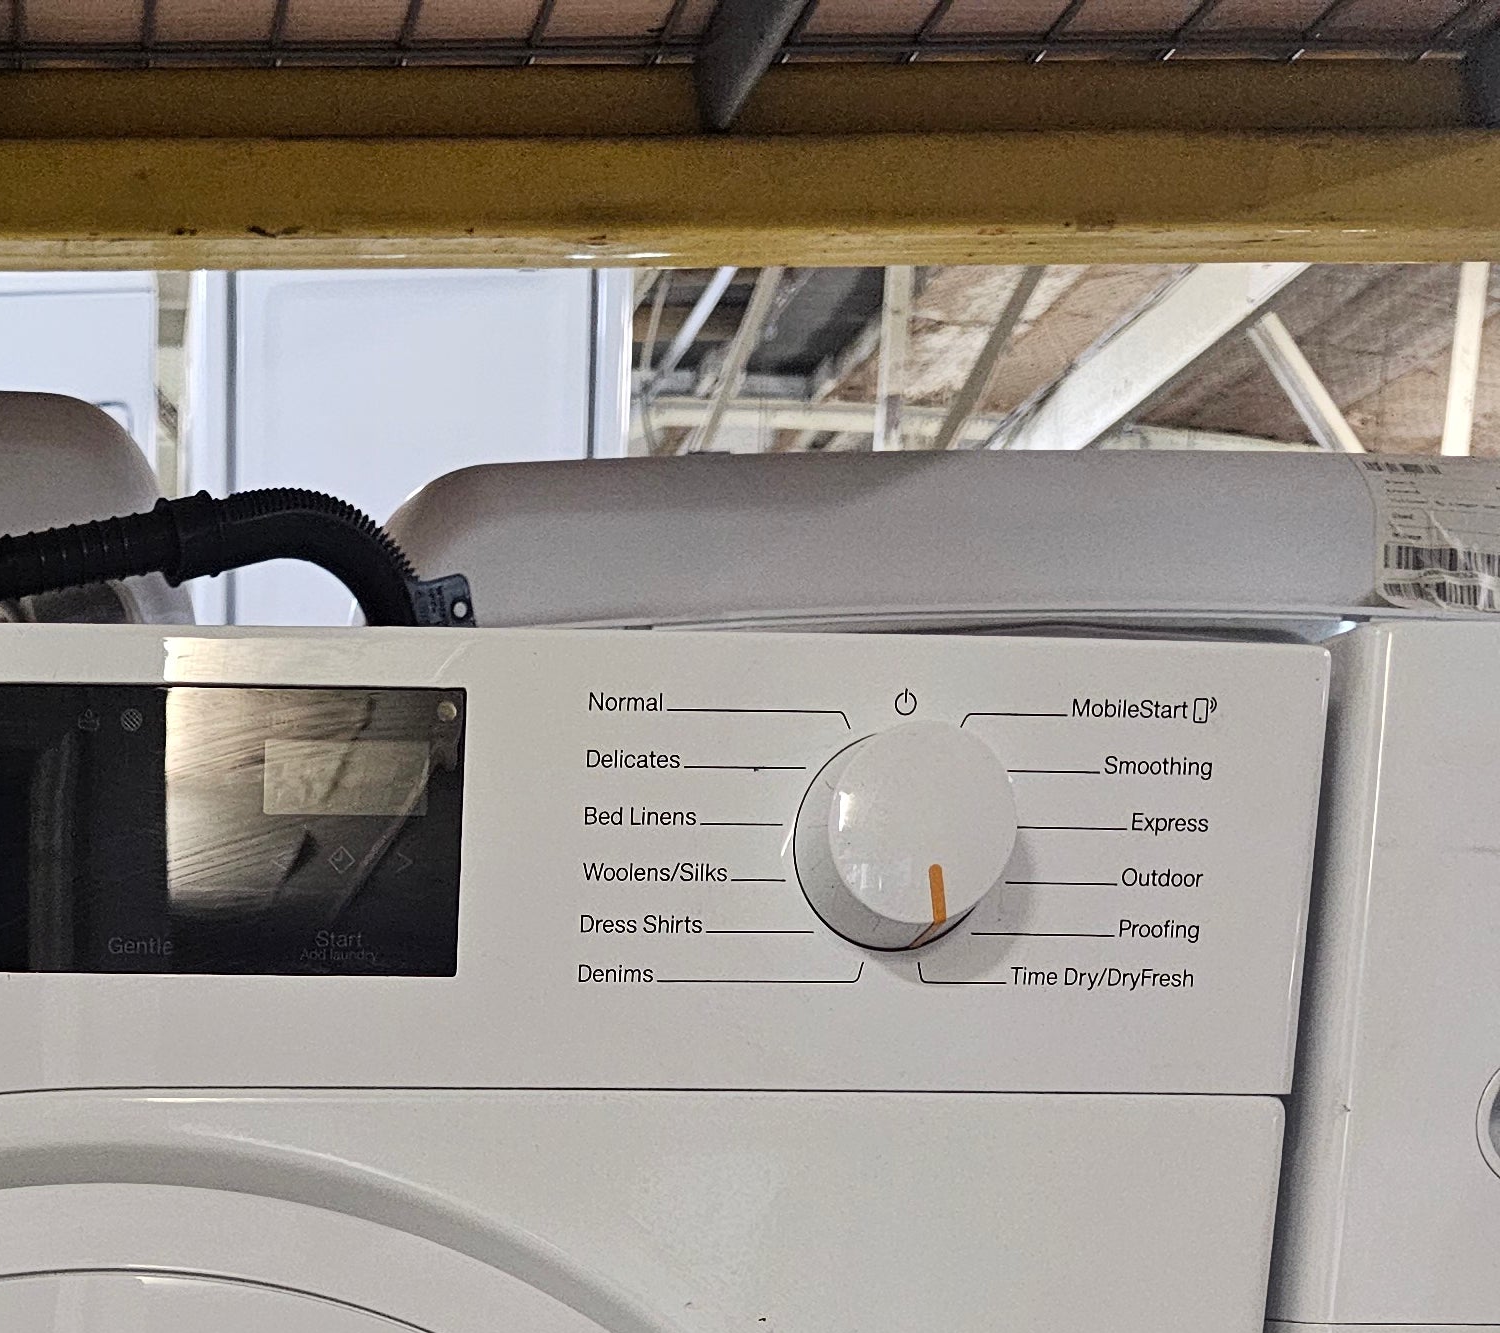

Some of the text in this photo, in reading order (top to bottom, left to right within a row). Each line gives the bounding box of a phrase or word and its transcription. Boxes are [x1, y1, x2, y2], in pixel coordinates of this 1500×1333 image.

[588, 691, 663, 712] Normal
[1071, 698, 1189, 720] MobileStart
[586, 749, 681, 769] Delicates
[1104, 755, 1213, 781] Smoothing
[584, 806, 697, 826] Bed Linens
[1131, 812, 1209, 837] Express
[582, 862, 728, 882] Woolens/Silks
[1121, 867, 1204, 888] Outdoor
[580, 914, 703, 934] Dress Shirts
[1118, 919, 1200, 944] Proofing
[107, 935, 173, 955] Gentle
[315, 929, 362, 948] Start
[578, 963, 654, 983] Denims
[1010, 966, 1194, 992] Time Dry/DryFresh
